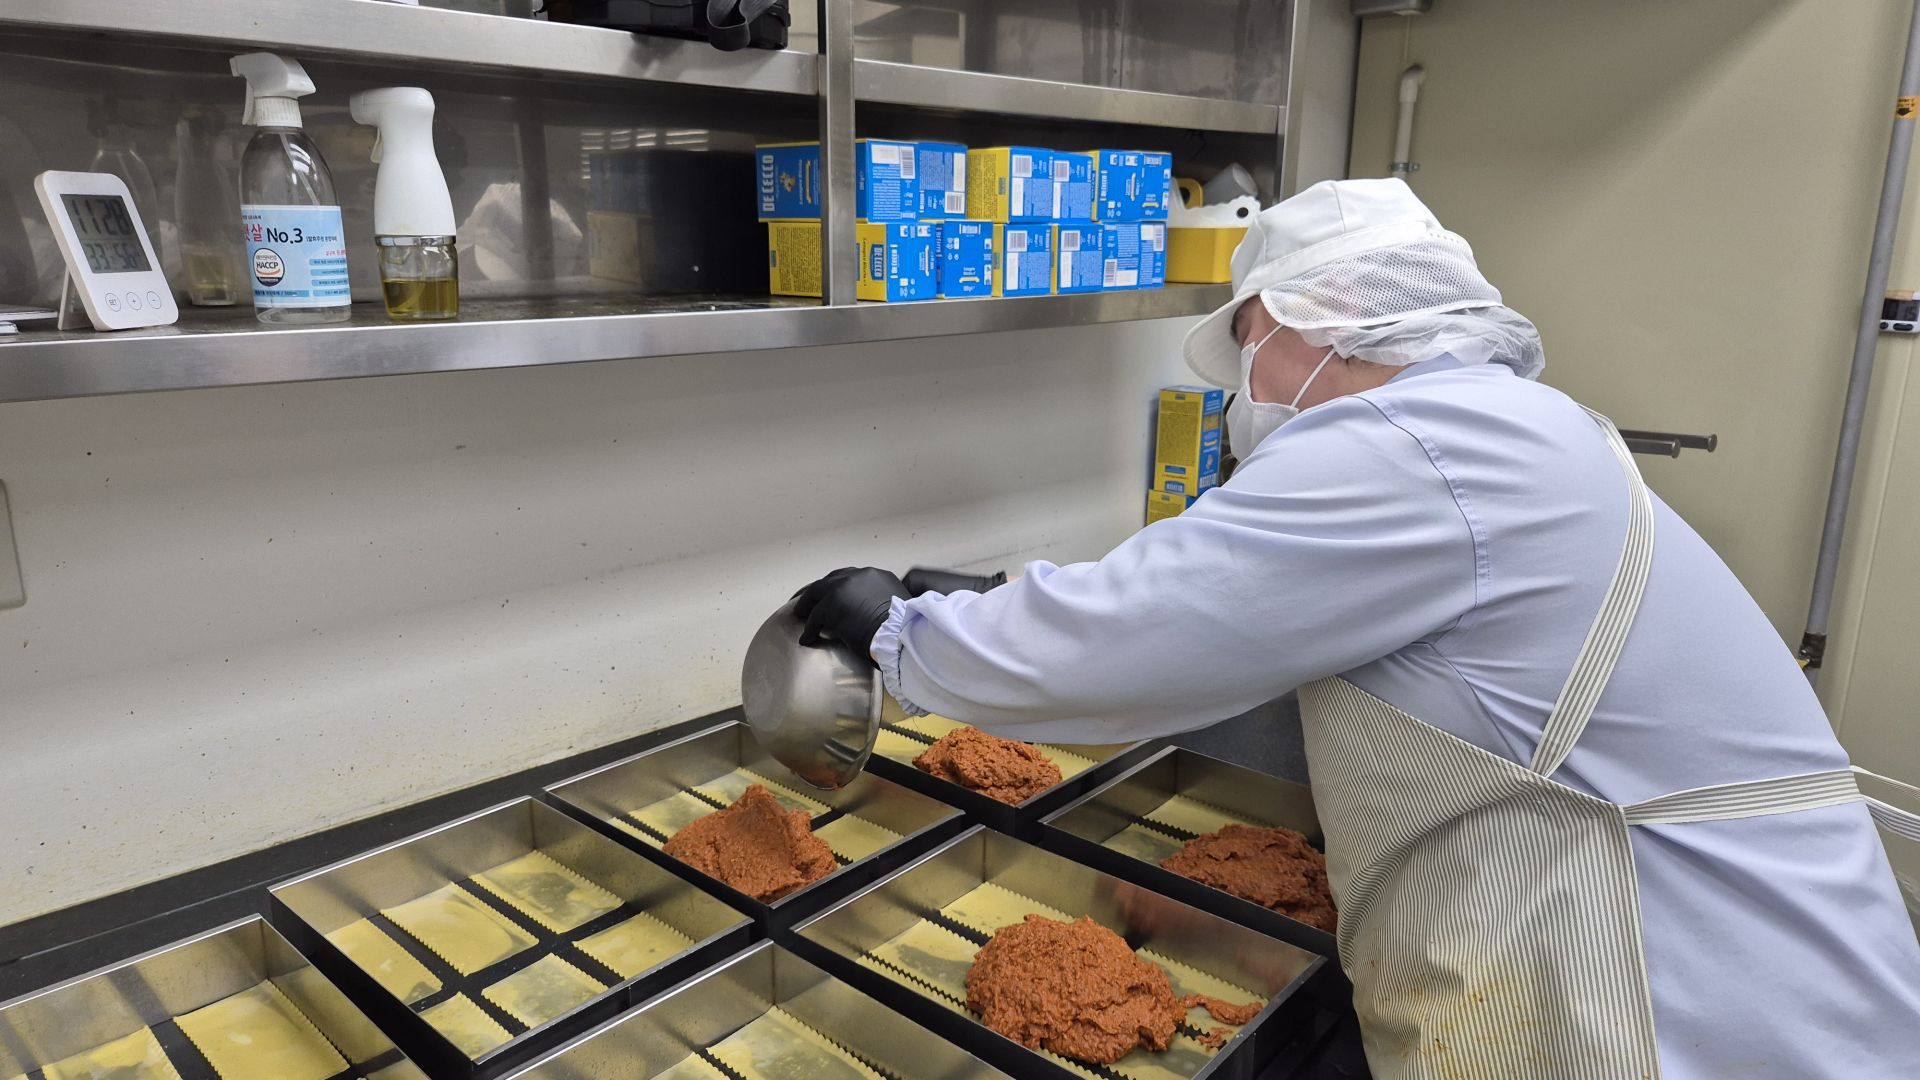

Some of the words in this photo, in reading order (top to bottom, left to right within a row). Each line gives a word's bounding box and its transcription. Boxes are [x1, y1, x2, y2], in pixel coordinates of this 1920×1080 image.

[762, 154, 775, 194] CECCO
[762, 195, 776, 212] DE
[266, 227, 303, 244] No.3
[256, 261, 279, 269] HACCP
